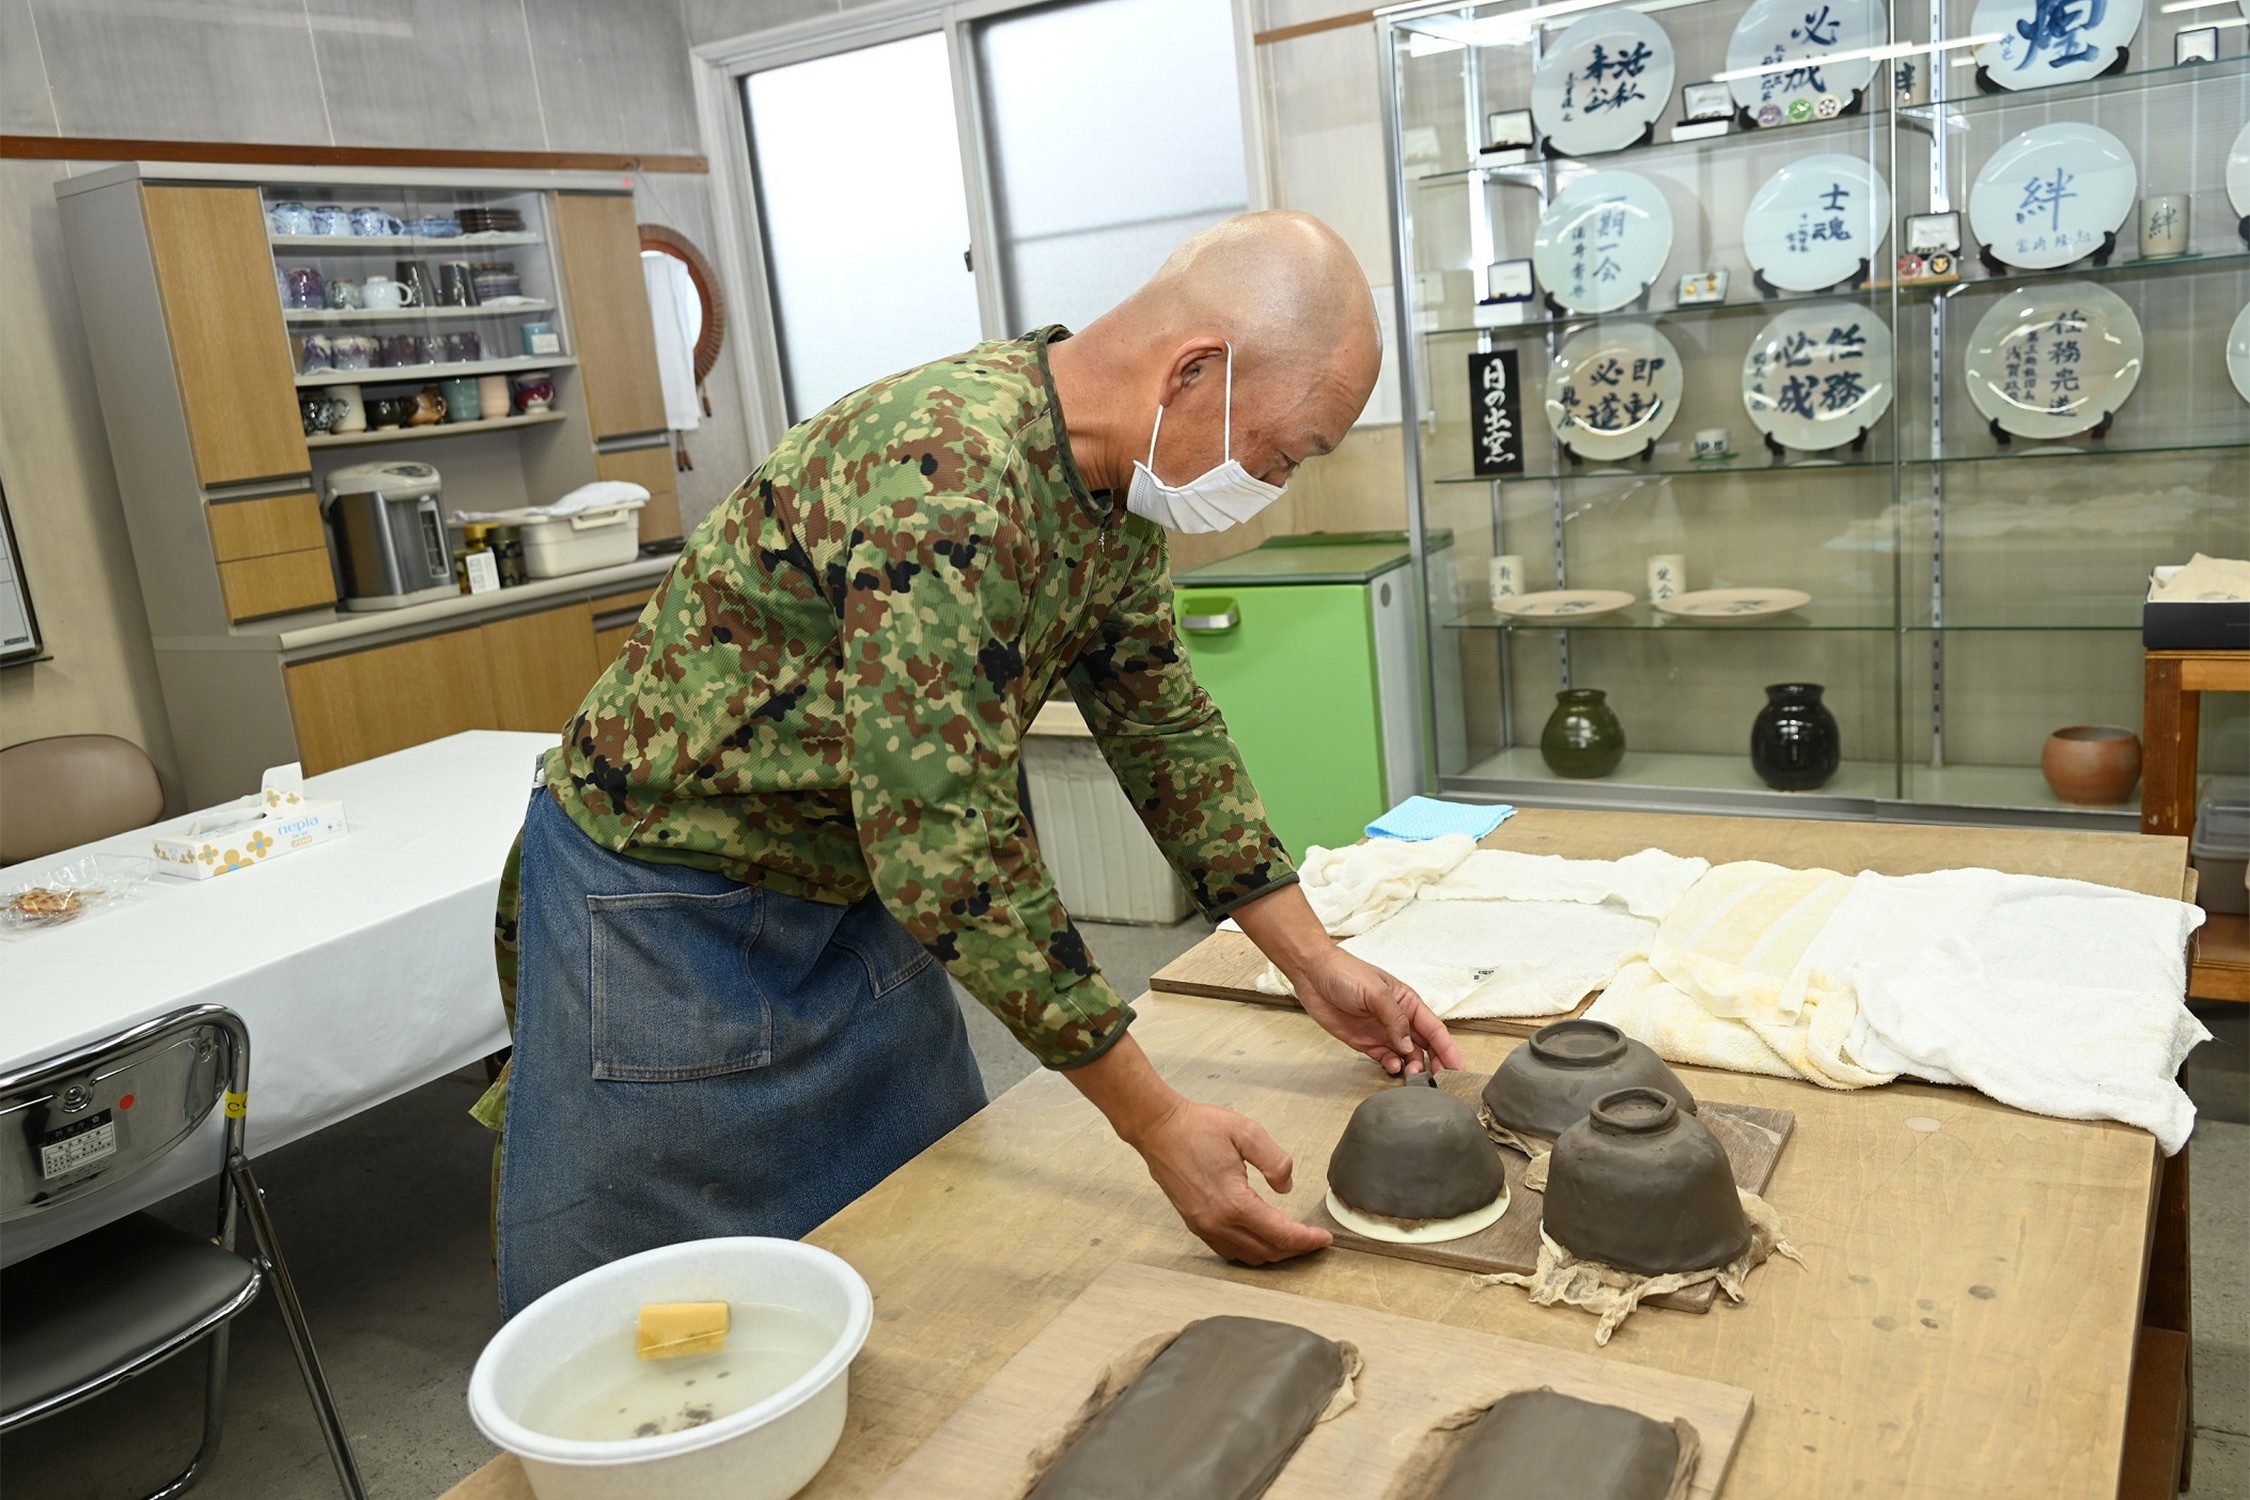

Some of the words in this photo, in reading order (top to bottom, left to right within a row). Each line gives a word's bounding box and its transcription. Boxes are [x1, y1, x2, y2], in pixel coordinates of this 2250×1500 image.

[1811, 182, 1852, 241] 士魂
[2015, 166, 2078, 232] 絆
[1592, 195, 1627, 282] 一期一会
[277, 815, 320, 837] nepia
